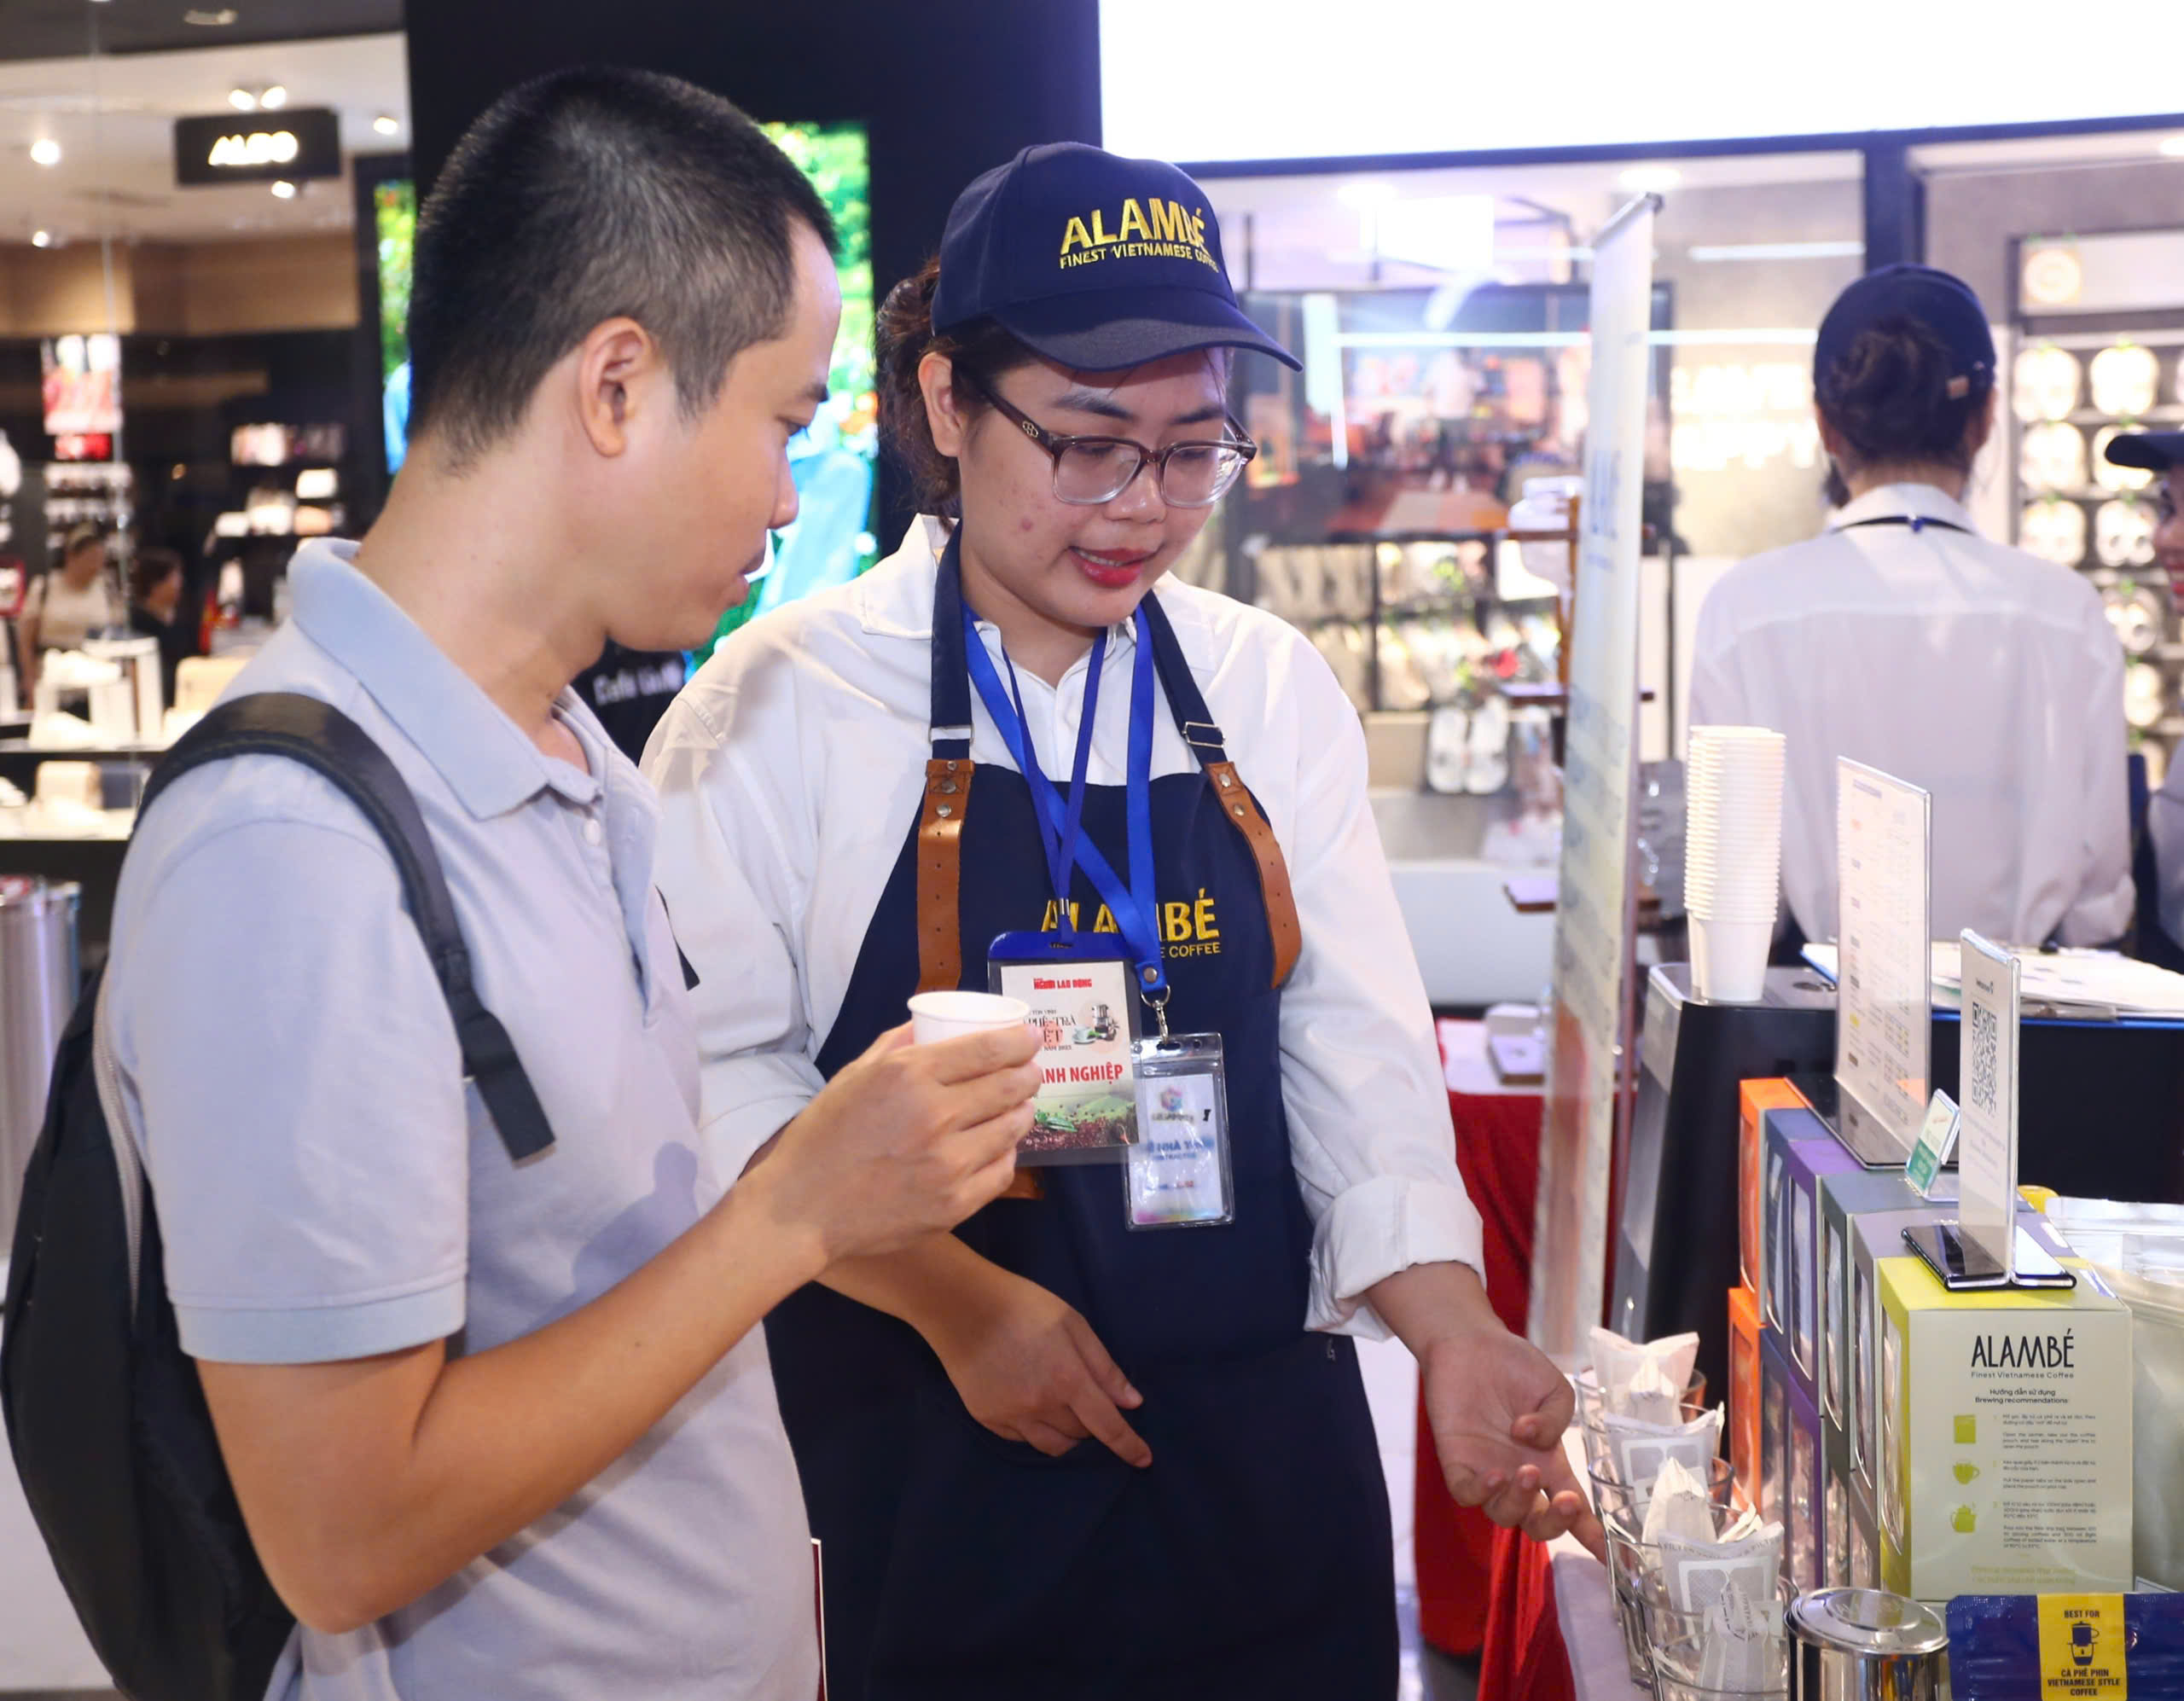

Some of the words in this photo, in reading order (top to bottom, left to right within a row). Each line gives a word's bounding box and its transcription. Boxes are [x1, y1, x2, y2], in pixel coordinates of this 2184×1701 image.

[1060, 248, 1107, 270] FINEST
[1111, 242, 1193, 260] VIETNAMESE
[1041, 887, 1220, 942] AABÉ
[1169, 942, 1222, 958] COFFEE
[1070, 1061, 1124, 1085] NGHIỆP
[1971, 1327, 2075, 1368] ALAMBÉ
[2064, 1610, 2083, 1618] BEST
[2085, 1610, 2100, 1618] FOR
[2048, 1678, 2096, 1686] VIETNAMESE
[2098, 1678, 2121, 1686] STYLE
[2090, 1669, 2109, 1677] PHIN
